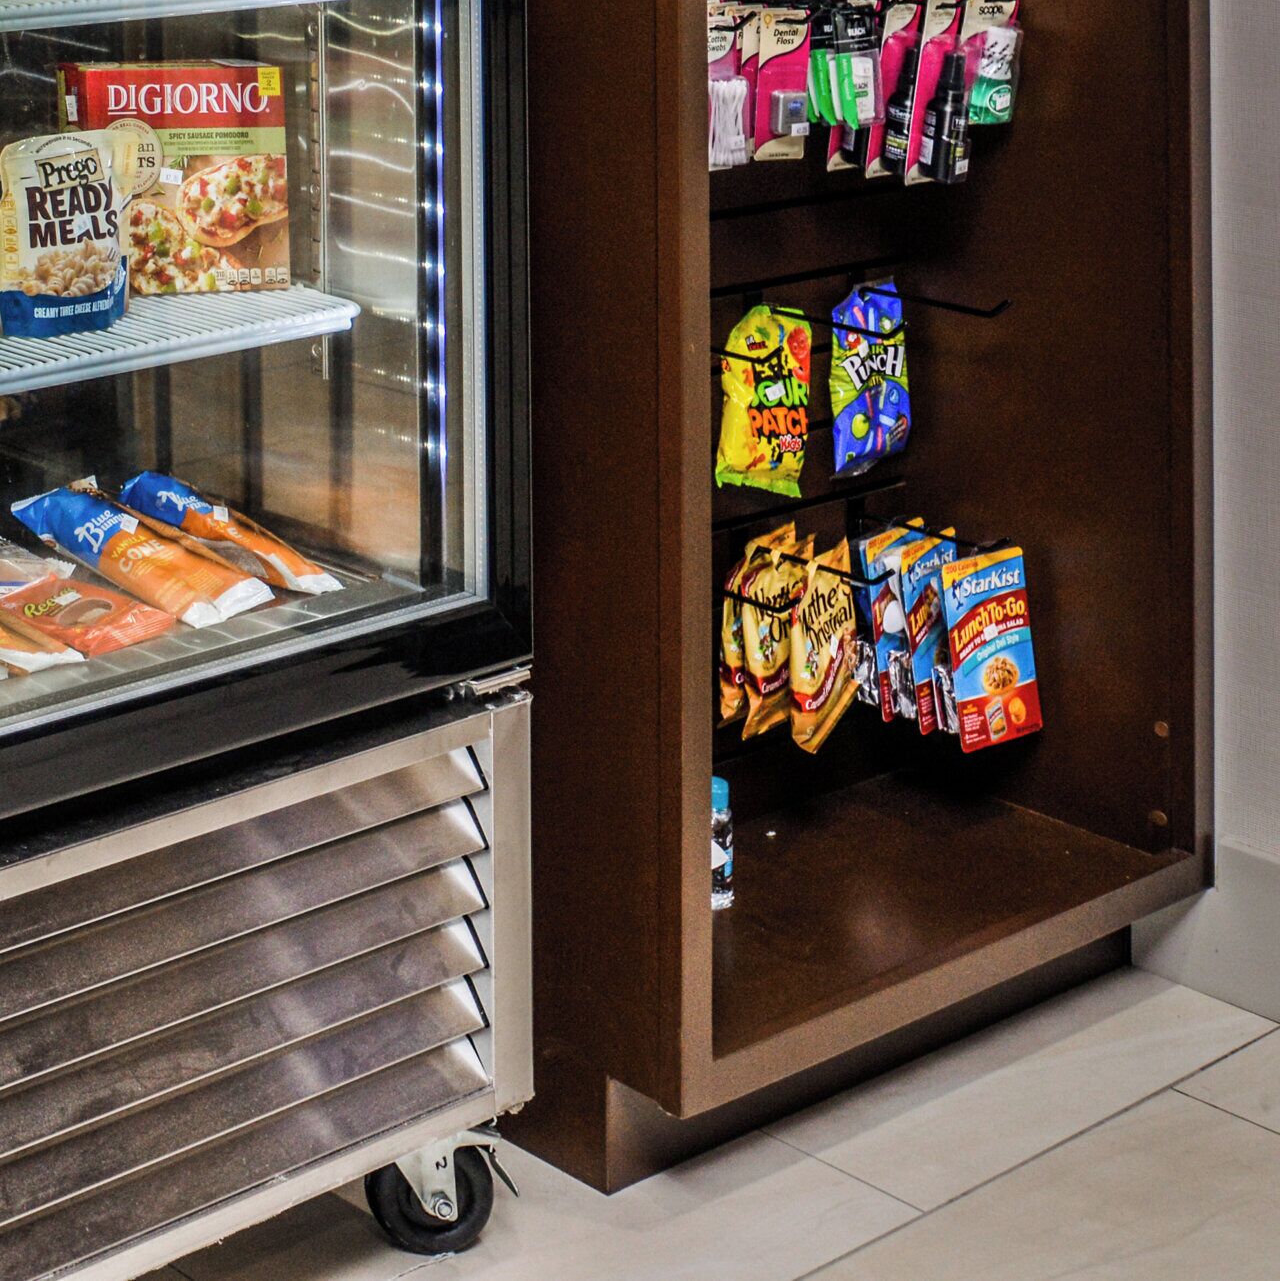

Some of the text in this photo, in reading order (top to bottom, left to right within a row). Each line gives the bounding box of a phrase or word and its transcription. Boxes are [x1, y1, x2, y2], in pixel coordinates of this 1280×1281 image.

[978, 5, 1004, 17] scope
[708, 35, 728, 45] Cotton
[773, 28, 799, 39] Dental
[776, 36, 795, 46] Floss
[847, 27, 866, 37] REACH
[708, 43, 727, 53] Swabs
[168, 130, 249, 140] SPICY SAUSAGE POMODORO
[39, 155, 98, 189] Prego
[25, 181, 114, 222] READY
[28, 209, 119, 249] MEALS
[34, 303, 91, 319] CREAMY THREE CHEESE
[841, 345, 905, 391] PUNCH
[778, 434, 803, 452] Kids
[74, 510, 113, 554] Blue
[110, 534, 145, 560] VANILLA
[119, 538, 166, 573] CONE
[961, 566, 1021, 598] StarKist
[953, 609, 991, 654] Lunch
